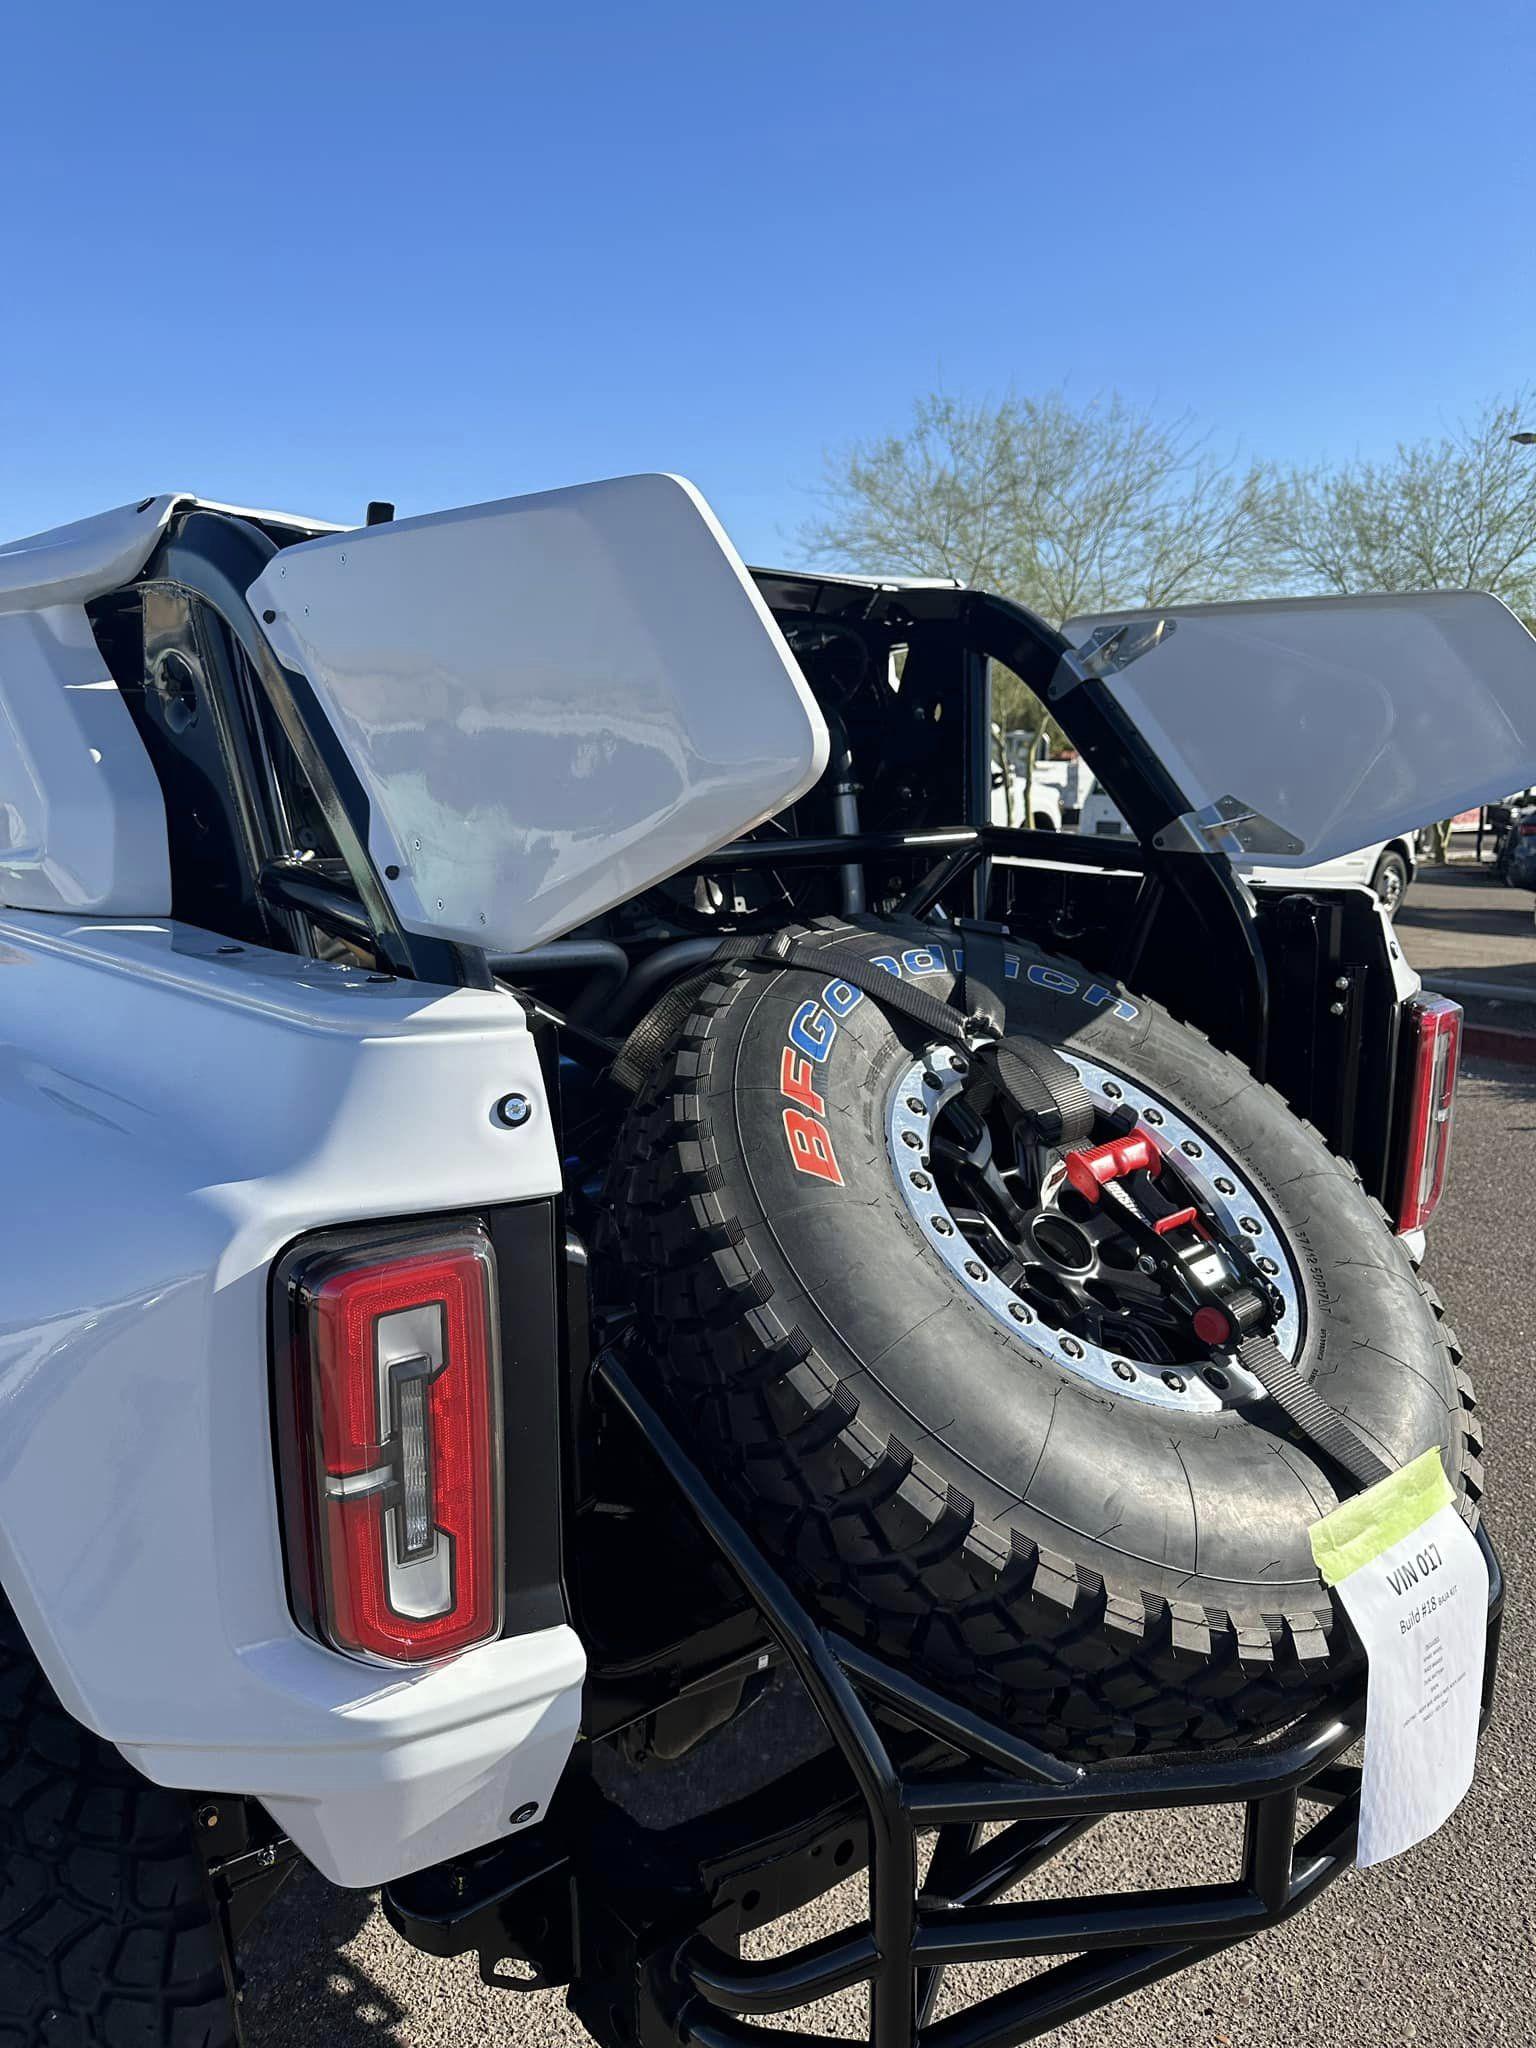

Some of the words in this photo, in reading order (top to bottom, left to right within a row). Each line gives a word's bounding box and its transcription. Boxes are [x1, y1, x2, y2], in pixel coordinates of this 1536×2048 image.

[780, 944, 1139, 1187] BFGodich
[1386, 1561, 1418, 1596] VIN
[1416, 1542, 1442, 1577] 017
[1399, 1606, 1421, 1635] Build
[1421, 1596, 1437, 1618] #18
